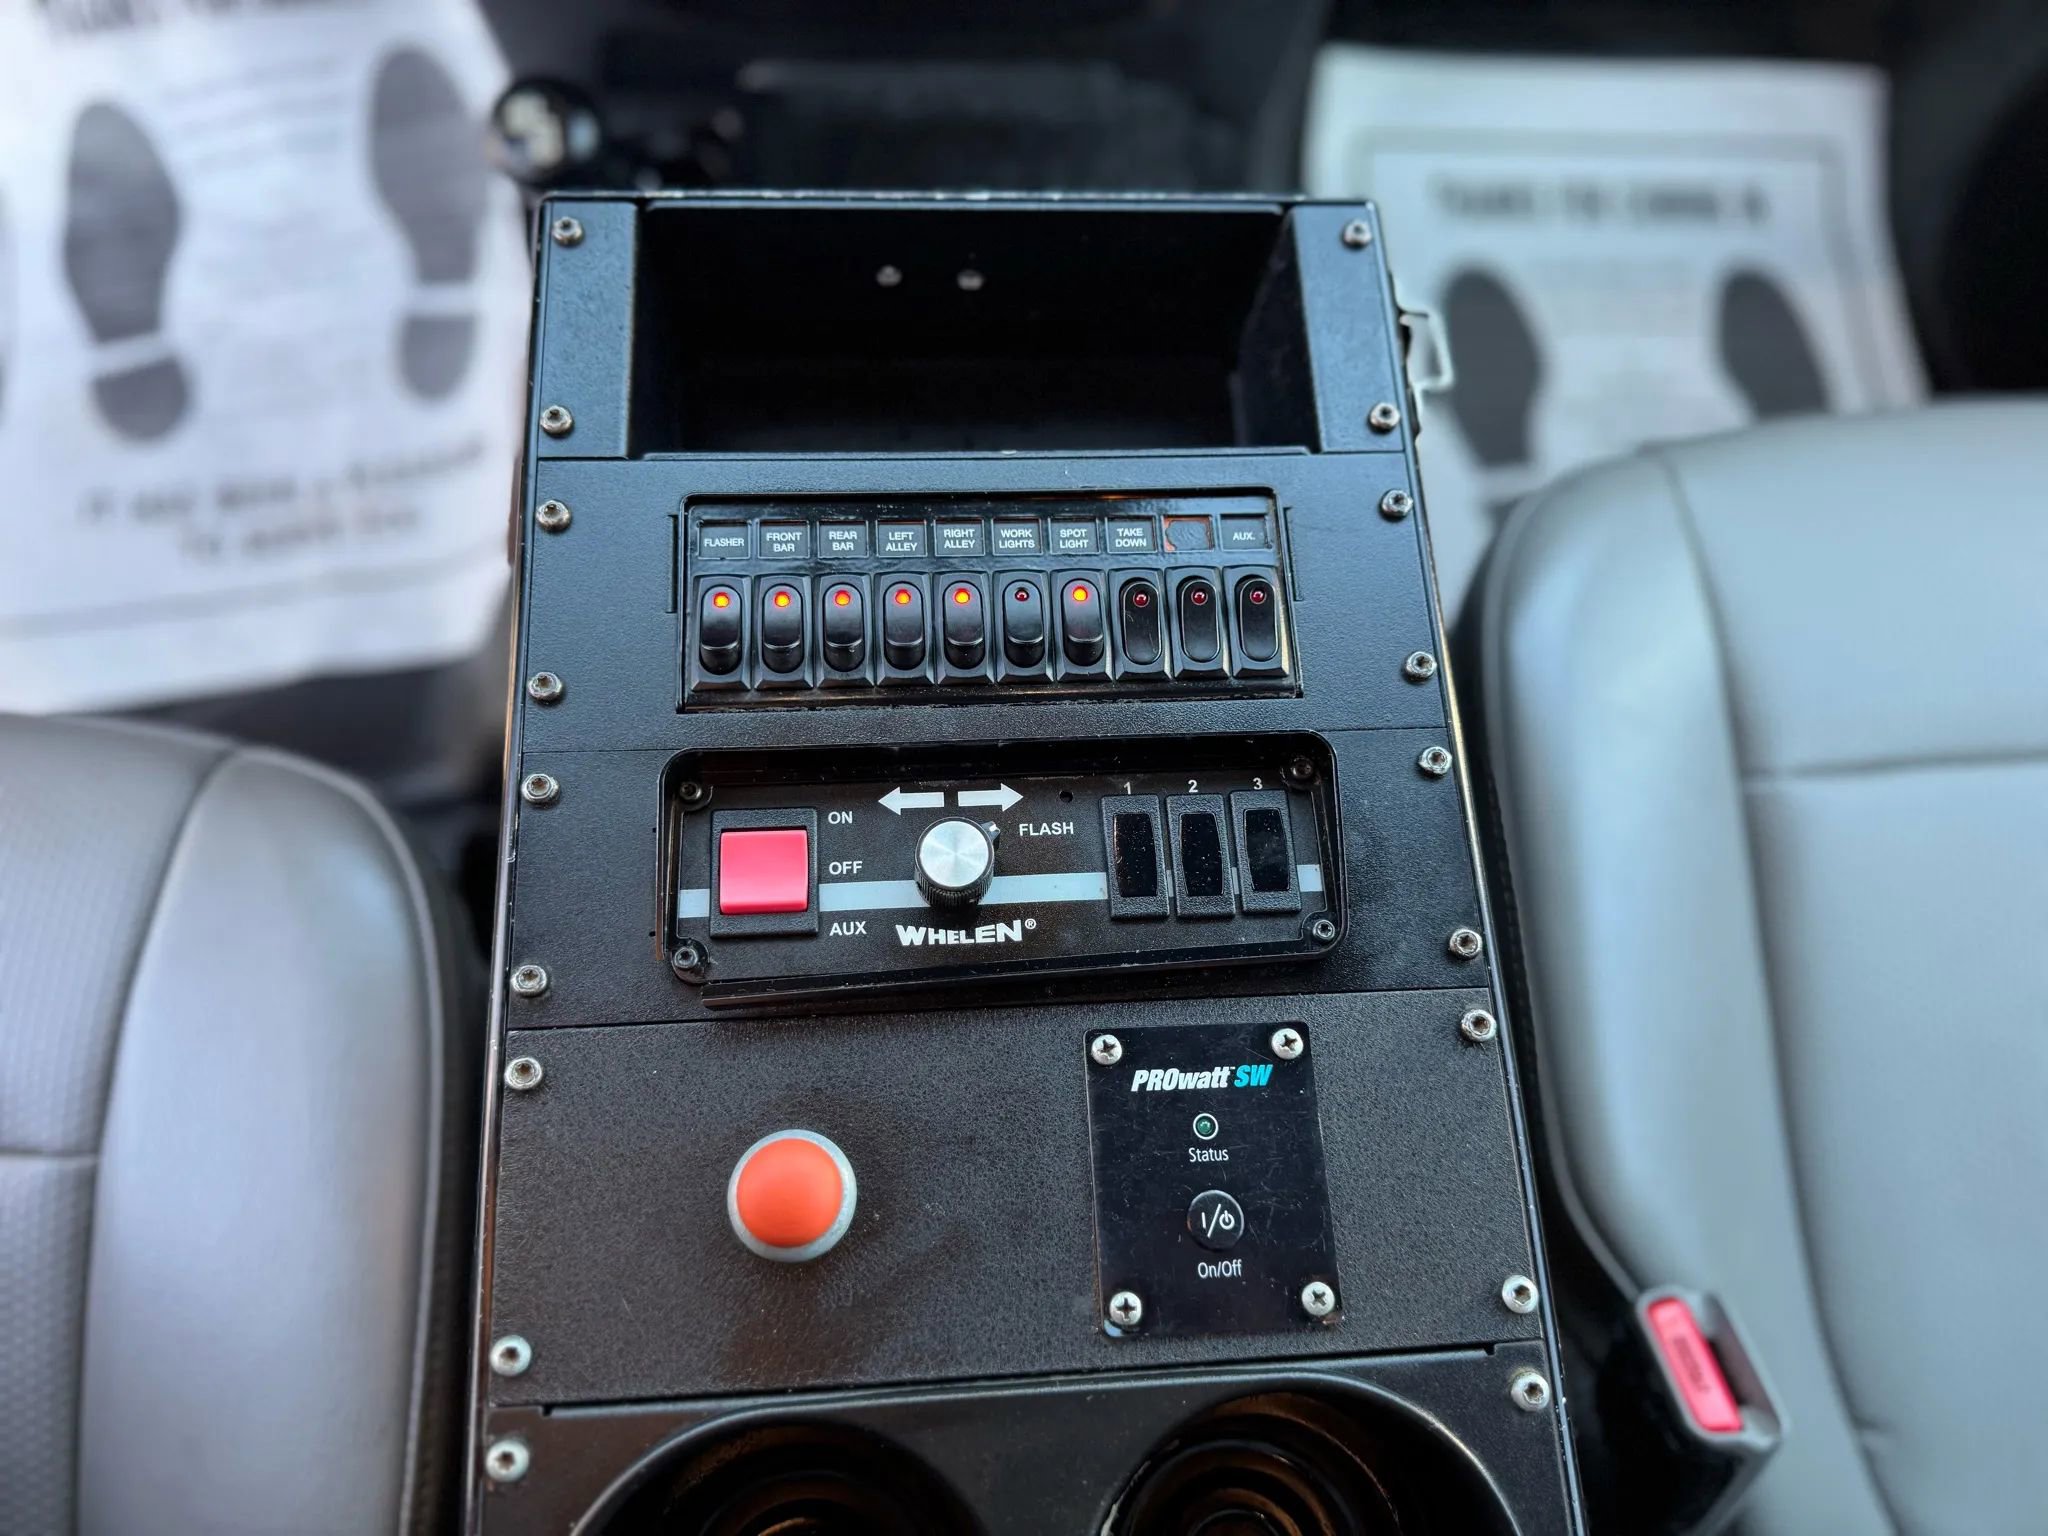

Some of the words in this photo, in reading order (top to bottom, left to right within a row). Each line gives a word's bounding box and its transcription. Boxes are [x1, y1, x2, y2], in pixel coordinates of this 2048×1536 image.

[766, 532, 802, 542] FRONT
[828, 530, 858, 540] REAR
[888, 531, 914, 541] LEFT
[943, 528, 976, 538] RIGHT
[1000, 528, 1033, 538] WORK
[1059, 528, 1087, 538] SPOT
[1116, 527, 1144, 537] TAKE
[1232, 532, 1255, 541] AUX.
[704, 538, 745, 548] FLASHER
[773, 542, 795, 552] BAR
[832, 541, 854, 551] BAR
[885, 542, 918, 551] ALLEY
[943, 539, 976, 549] ALLEY
[998, 539, 1036, 549] LIGHTS
[1059, 539, 1089, 549] LIGHT
[1115, 538, 1147, 547] DOWN
[1123, 781, 1132, 795] 1
[1188, 779, 1199, 793] 2
[1252, 777, 1263, 790] 3
[828, 810, 853, 825] ON
[1018, 821, 1074, 837] FLASH
[828, 860, 863, 876] OFF
[829, 920, 867, 937] AUX
[1232, 1064, 1273, 1088] SW
[1188, 1147, 1229, 1163] Status
[1197, 1258, 1242, 1279] On/Off
